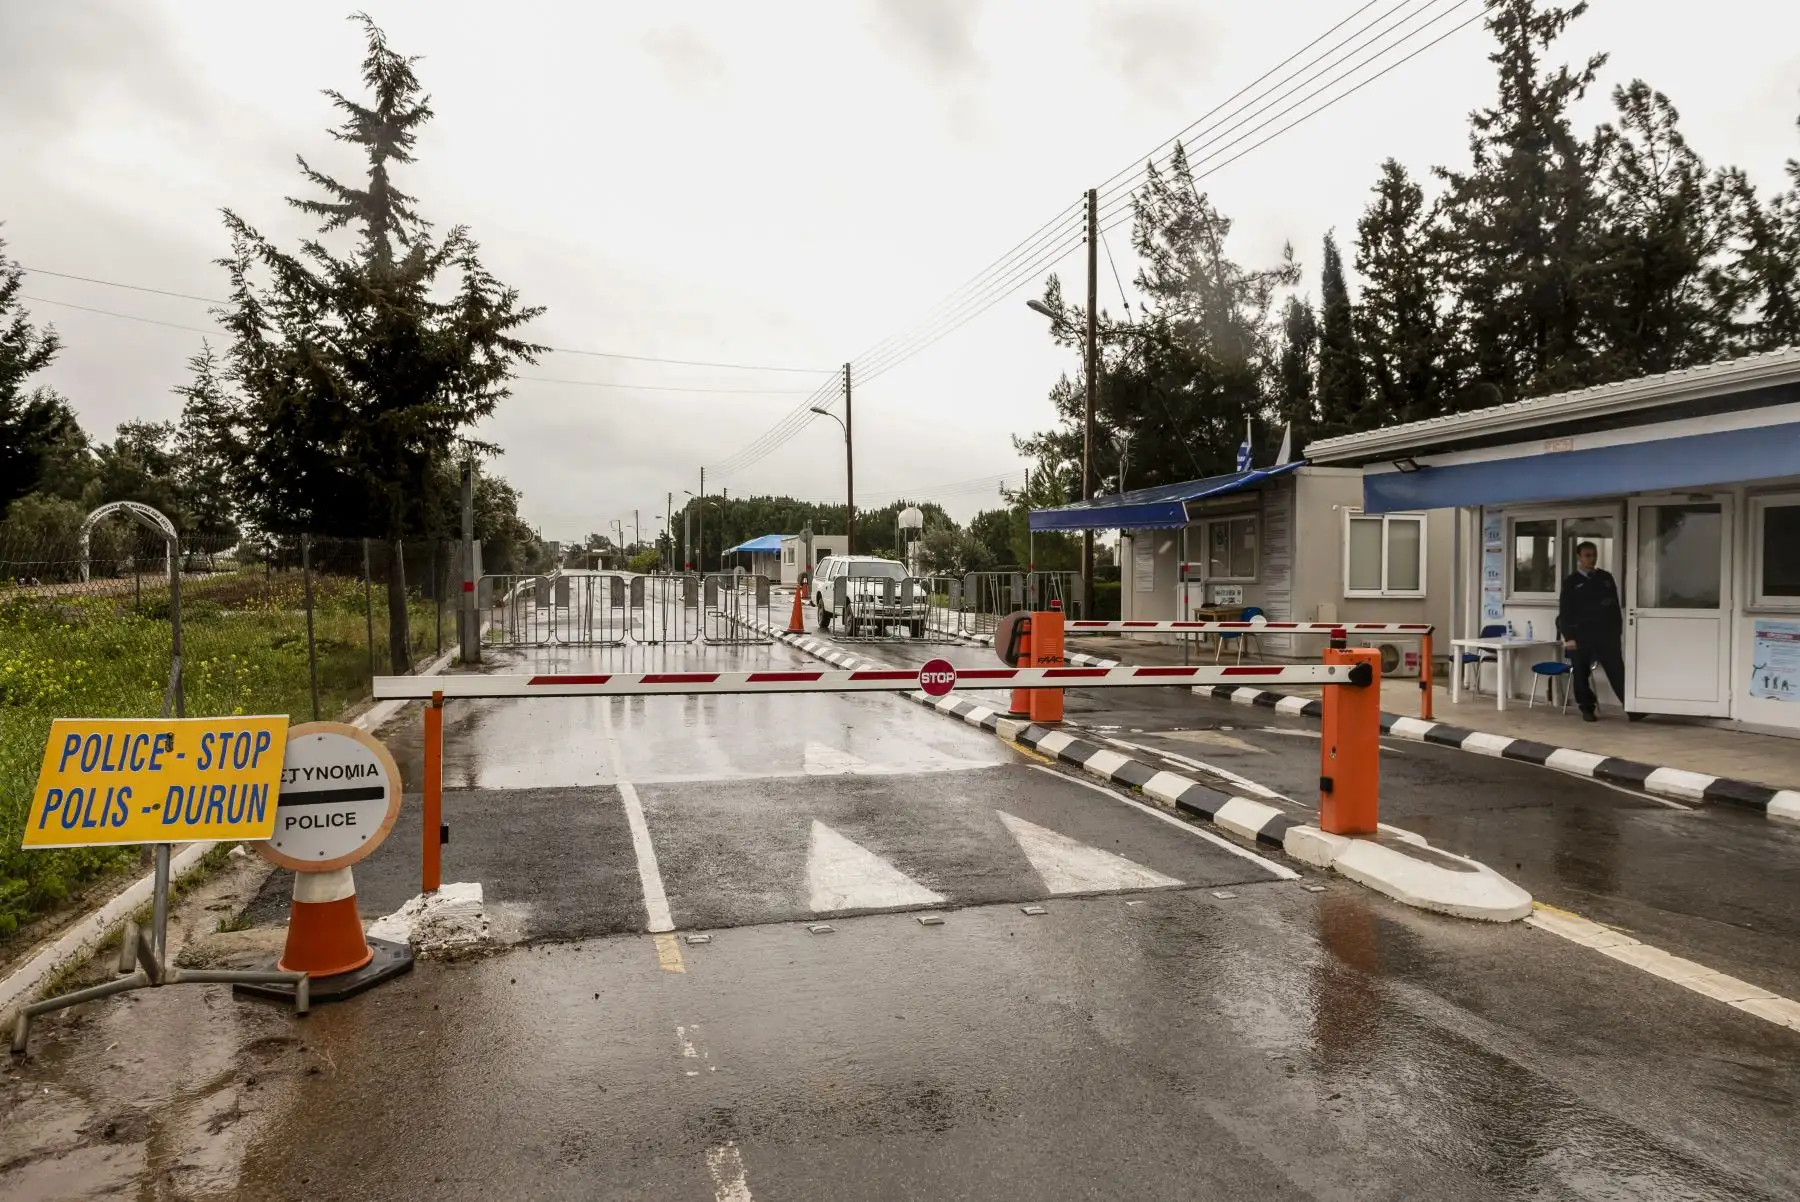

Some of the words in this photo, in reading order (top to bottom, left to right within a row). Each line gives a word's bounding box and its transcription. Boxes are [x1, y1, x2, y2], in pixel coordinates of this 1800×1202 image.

[1037, 656, 1063, 664] FAAC
[921, 672, 955, 684] STOP
[59, 733, 167, 773] POLICE
[197, 730, 271, 771] STOP
[280, 763, 379, 784] ΣΤΥΝΟΜΙΑ
[38, 785, 133, 830] POLIS
[162, 783, 269, 825] DURUN
[285, 812, 357, 831] POLICE
